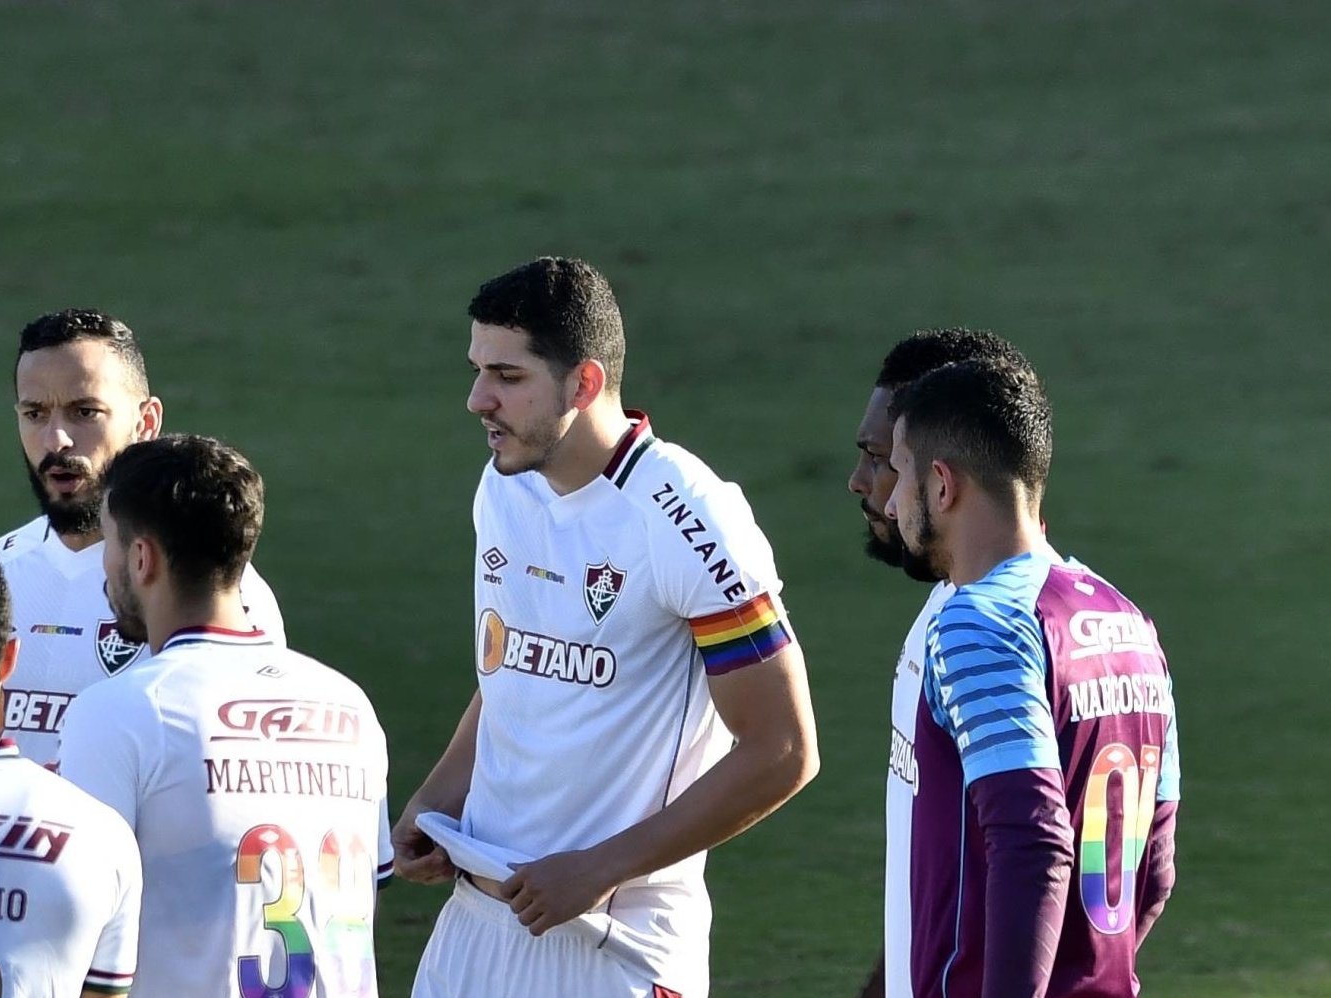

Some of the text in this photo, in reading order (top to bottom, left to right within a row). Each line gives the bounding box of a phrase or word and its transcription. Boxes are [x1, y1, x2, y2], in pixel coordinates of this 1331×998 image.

[652, 482, 746, 603] ZINZANE
[504, 630, 614, 685] BETANO
[5, 692, 70, 731] BET
[216, 700, 360, 744] GAZIN
[204, 759, 376, 804] MARTINELL
